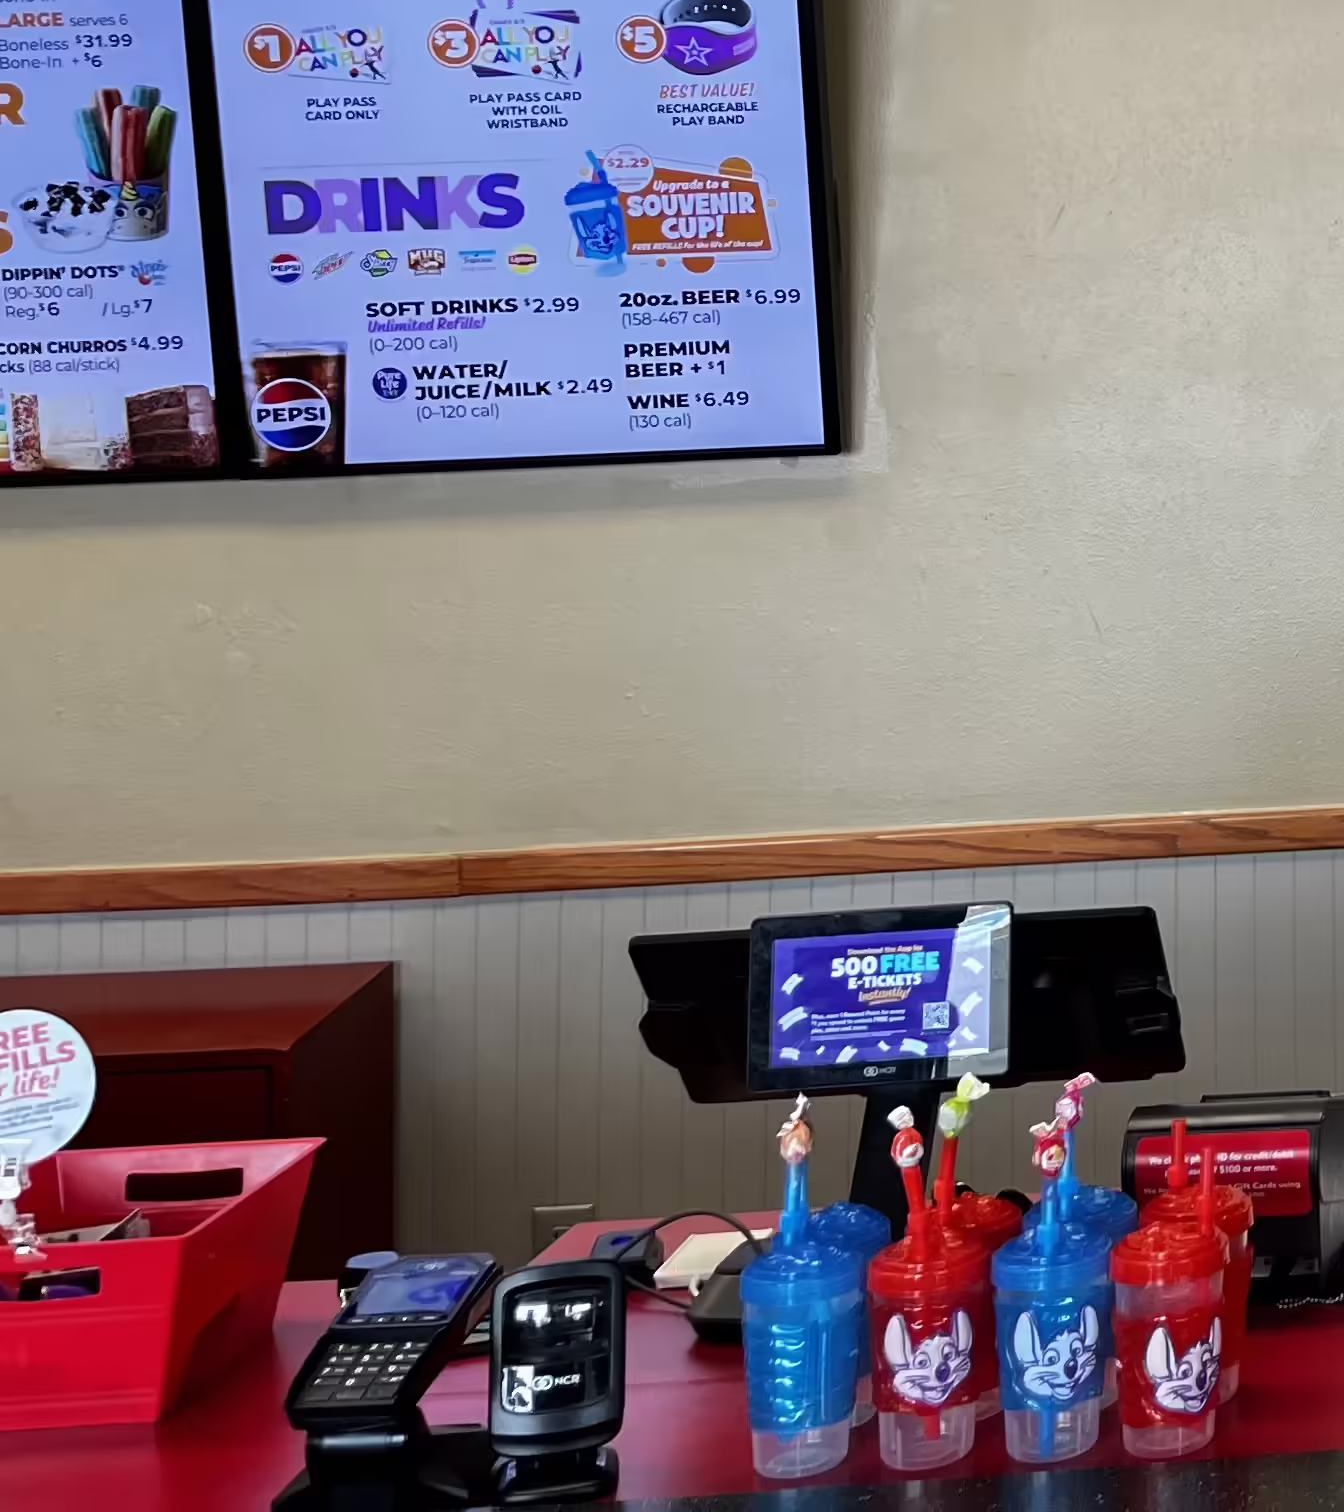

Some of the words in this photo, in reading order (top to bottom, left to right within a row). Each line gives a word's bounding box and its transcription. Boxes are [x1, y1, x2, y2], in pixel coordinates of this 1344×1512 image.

[69, 15, 115, 26] serves
[119, 14, 128, 25] 6
[75, 34, 132, 48] $31.99
[469, 93, 503, 105] PLAY
[507, 91, 541, 103] PASS
[544, 91, 582, 101] CARD
[659, 83, 698, 99] BEST
[701, 83, 755, 98] VALUE!
[307, 97, 340, 108] PLAY
[343, 96, 377, 107] PASS
[492, 105, 527, 116] WITH
[531, 104, 563, 115] COIL
[656, 101, 759, 114] RECHARGEABLE
[305, 110, 343, 121] CARD
[345, 109, 380, 120] ONLY
[486, 117, 569, 129] WRISTBAND
[672, 115, 705, 127] PLAY
[708, 114, 745, 125] BAND
[607, 157, 650, 169] $2.29
[653, 179, 704, 193] Upgrade
[706, 179, 718, 189] to
[263, 172, 525, 235] DRINKS
[627, 191, 756, 217] SOUVENIR
[661, 215, 725, 239] CUP!
[270, 264, 301, 272] PEPSI
[67, 284, 93, 299] cal)
[619, 292, 678, 308] 20oz.
[682, 289, 740, 305] BEER
[745, 288, 801, 305] $6.99
[366, 300, 425, 317] SOFT
[431, 297, 518, 316] DRINKS
[524, 296, 580, 313] $2.99
[367, 318, 434, 333] Unlimited
[437, 317, 486, 331] Refills!
[621, 312, 688, 329] (158-467
[692, 310, 721, 327] cal)
[47, 339, 127, 354] CHURROS
[131, 335, 183, 351] $4.99
[429, 335, 458, 353] cal)
[624, 339, 730, 359] PREMIUM
[56, 359, 120, 374] cal/stick)
[624, 361, 684, 378] BEER
[557, 378, 613, 395] $2.49
[627, 393, 689, 410] WINE
[695, 391, 749, 407] $6.49
[256, 407, 326, 424] PEPSI
[471, 404, 499, 420] cal)
[629, 414, 659, 431] (130
[664, 413, 692, 430] cal)
[831, 955, 878, 978] 500
[880, 951, 940, 974] FREE
[847, 973, 922, 989] E-TICKETS
[858, 986, 912, 1002] Instantly!
[14, 1067, 59, 1096] life!
[554, 1373, 580, 1386] NCR
